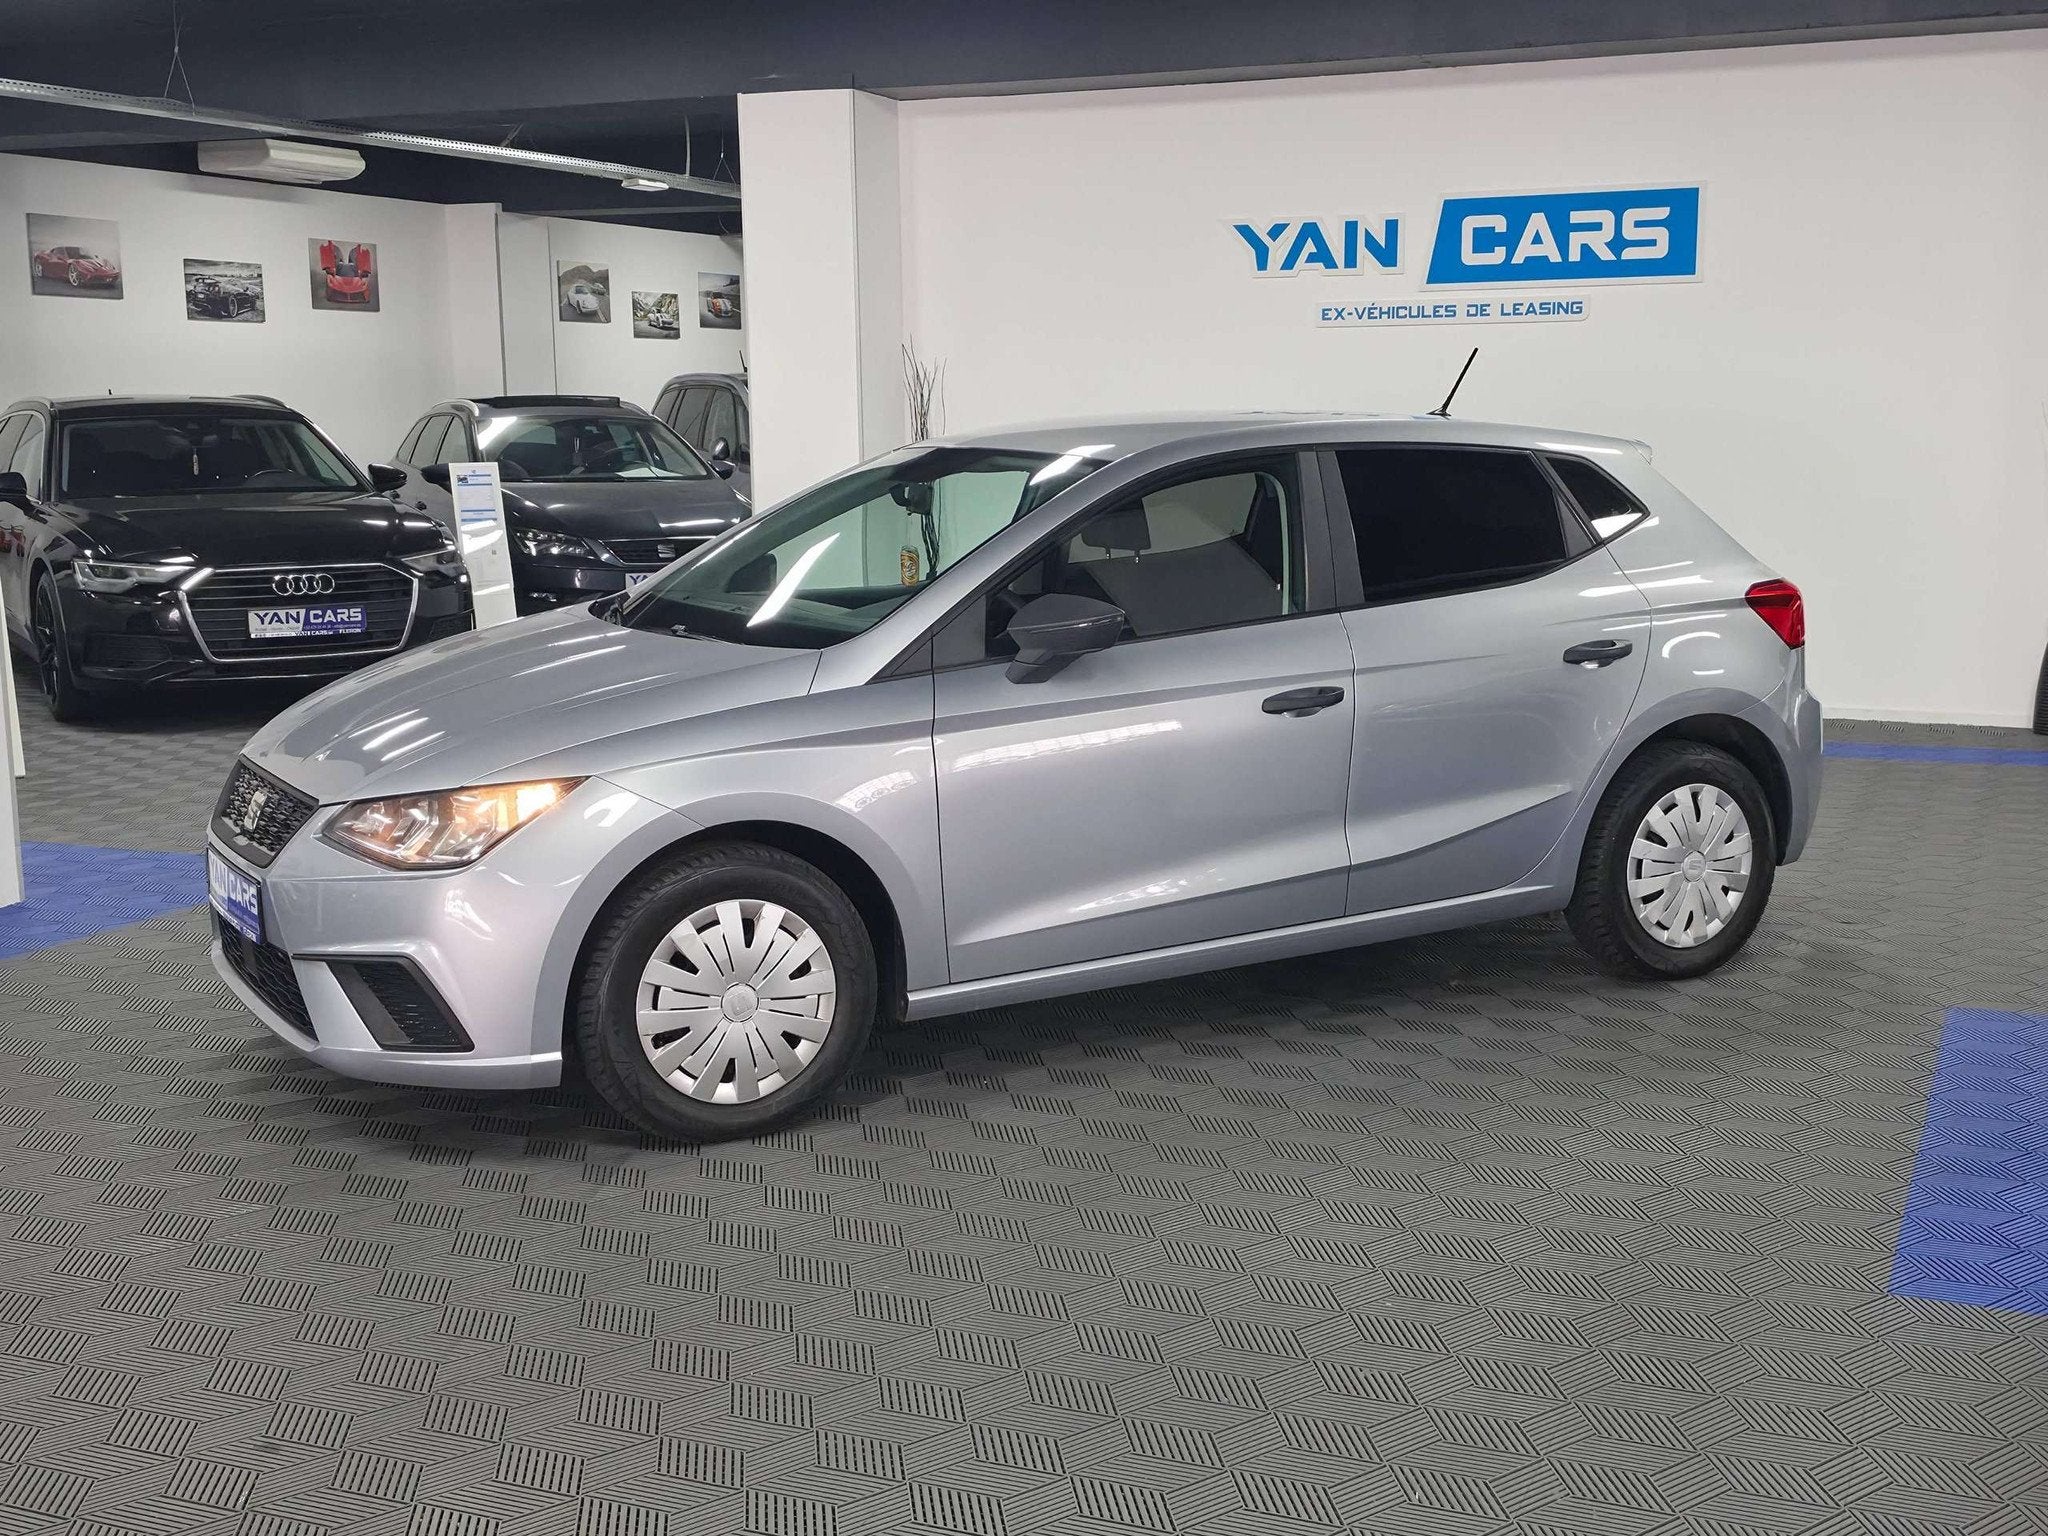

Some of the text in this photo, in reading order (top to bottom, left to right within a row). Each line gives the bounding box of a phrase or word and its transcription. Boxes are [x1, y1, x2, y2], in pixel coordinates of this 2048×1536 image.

[1232, 206, 1671, 272] YAN CARS
[1321, 300, 1583, 321] EX-VÉHICULES DE LEASING
[254, 608, 361, 626] YAN CARS
[229, 871, 258, 915] CARS
